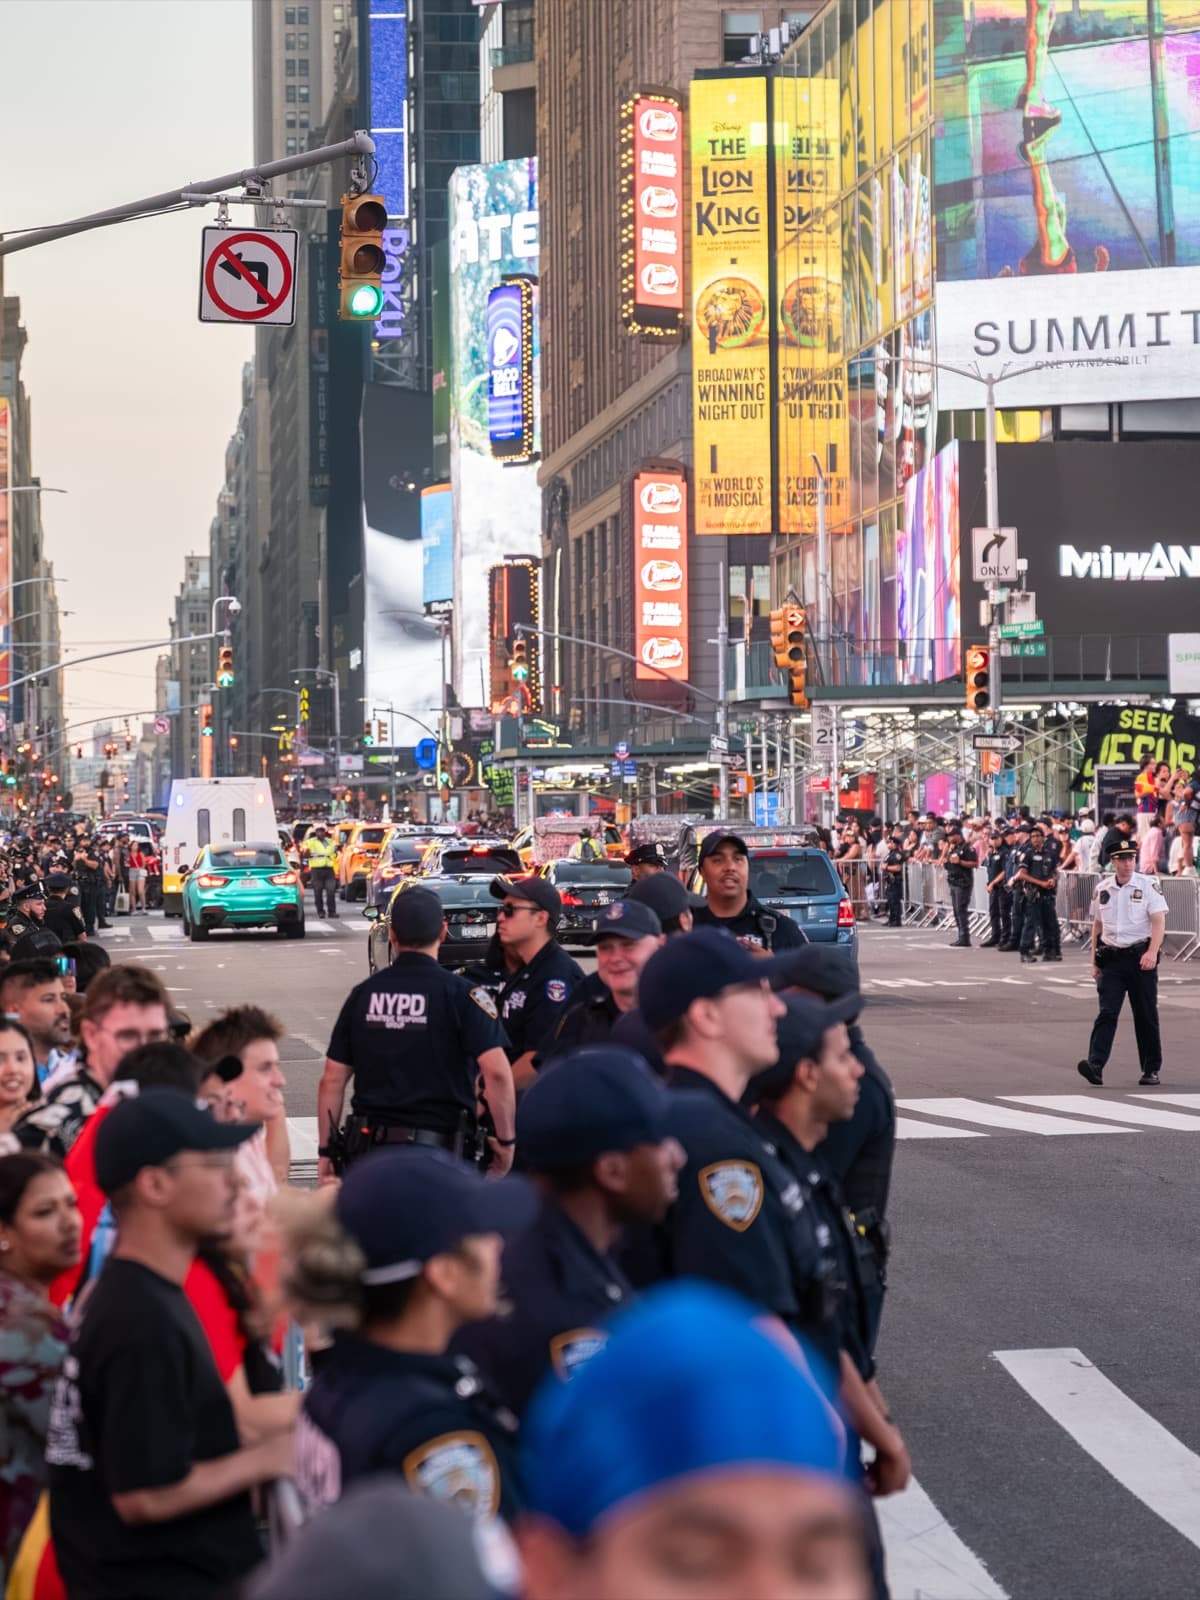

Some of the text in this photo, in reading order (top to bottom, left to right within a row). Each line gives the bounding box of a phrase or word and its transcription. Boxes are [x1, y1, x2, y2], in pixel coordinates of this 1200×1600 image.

[708, 138, 746, 155] THE
[702, 166, 753, 197] LION
[696, 201, 760, 236] KING
[698, 367, 766, 382] BROADWAY'S
[698, 383, 765, 402] WINNING
[698, 403, 766, 420] NIGHT OUT
[713, 476, 764, 492] WORLD'S
[714, 492, 764, 507] MUSICAL
[980, 566, 1010, 577] ONLY
[1119, 709, 1174, 734] SEEK
[369, 993, 426, 1016] NYPD
